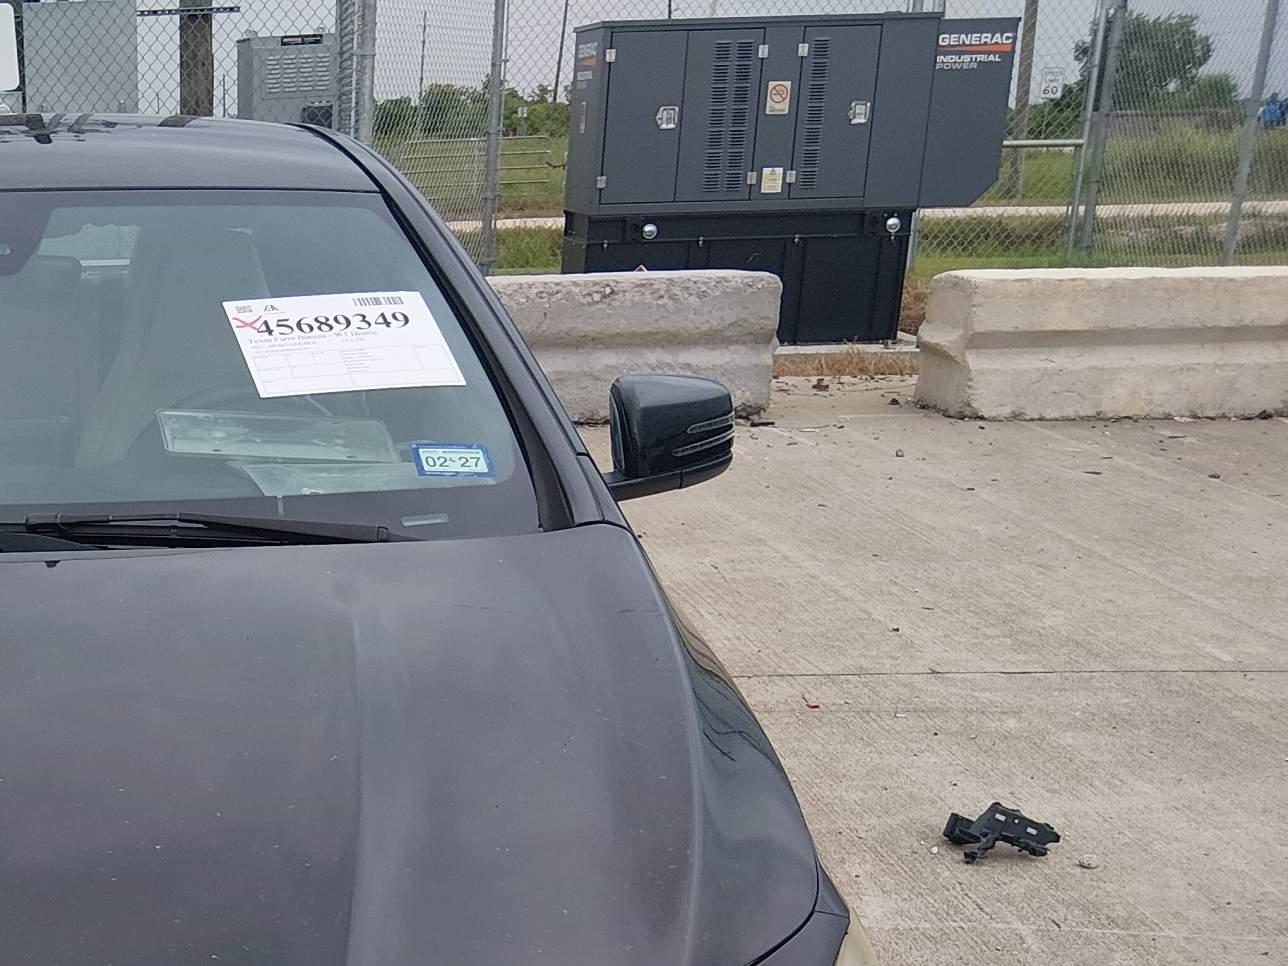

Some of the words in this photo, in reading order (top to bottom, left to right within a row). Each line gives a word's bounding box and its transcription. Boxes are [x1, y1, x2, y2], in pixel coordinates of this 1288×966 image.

[938, 33, 1014, 46] GENERAC
[936, 54, 1001, 63] INDUSTRIAL
[935, 62, 978, 70] POWER
[1042, 85, 1059, 96] 60
[257, 311, 410, 336] 45689349
